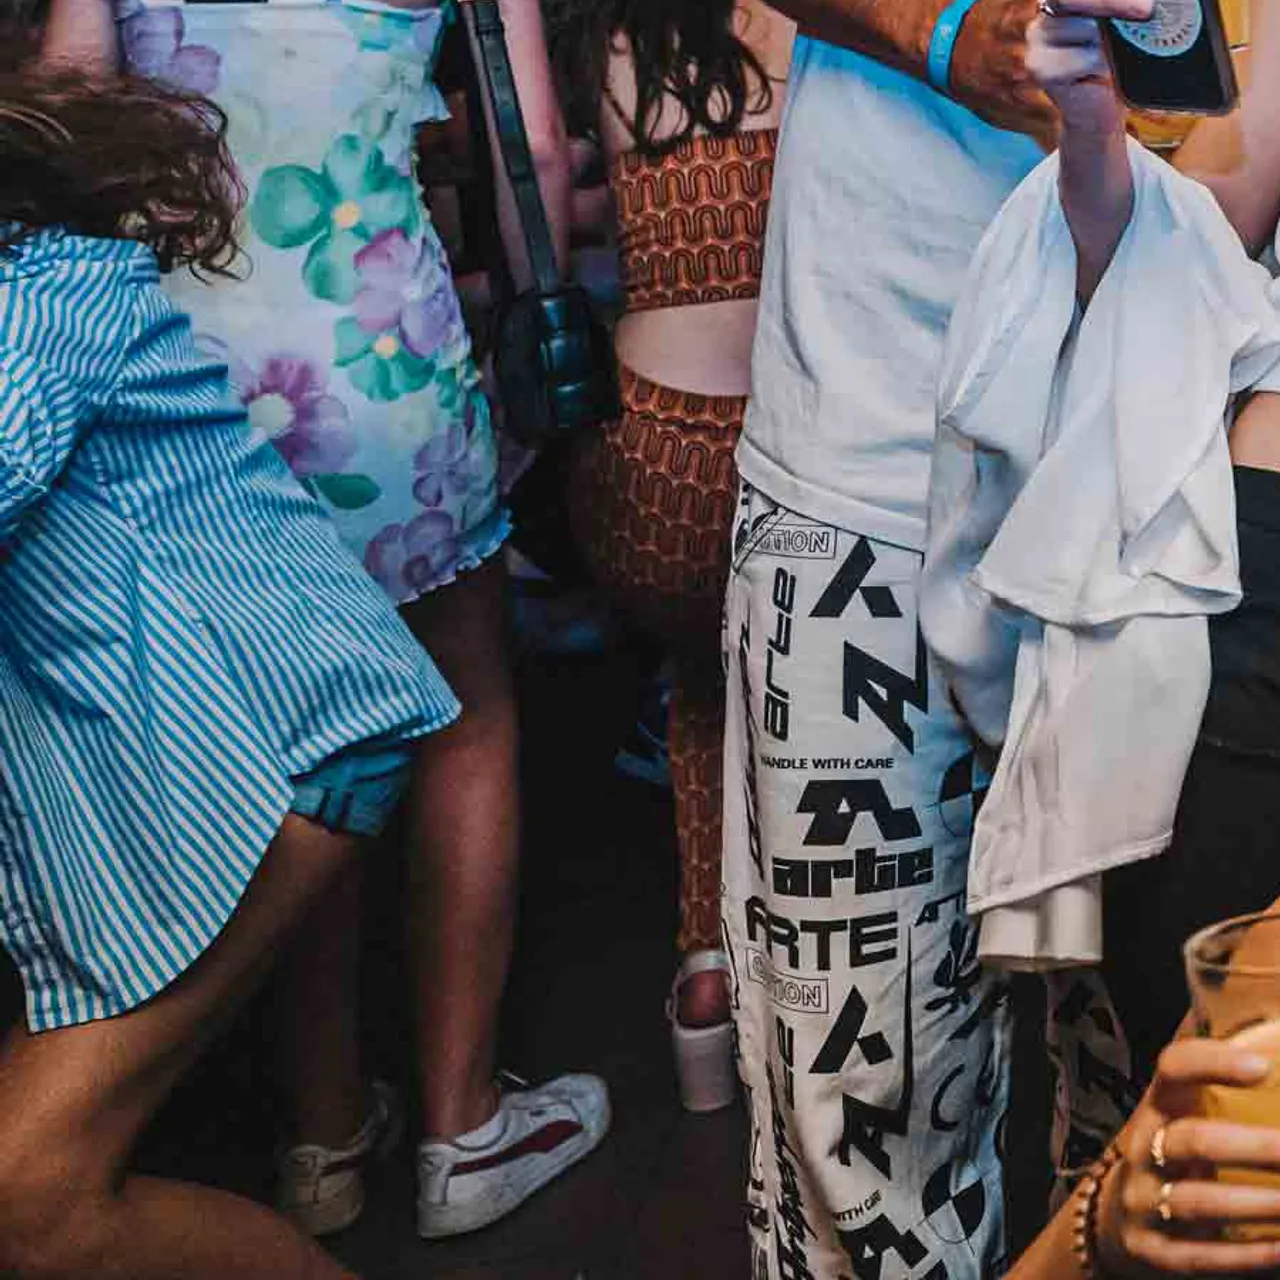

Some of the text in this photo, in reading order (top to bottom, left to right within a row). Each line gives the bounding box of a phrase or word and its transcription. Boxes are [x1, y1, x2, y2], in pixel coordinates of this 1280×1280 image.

[812, 756, 850, 769] WITH
[854, 755, 894, 769] CARE
[745, 894, 898, 971] ARTE
